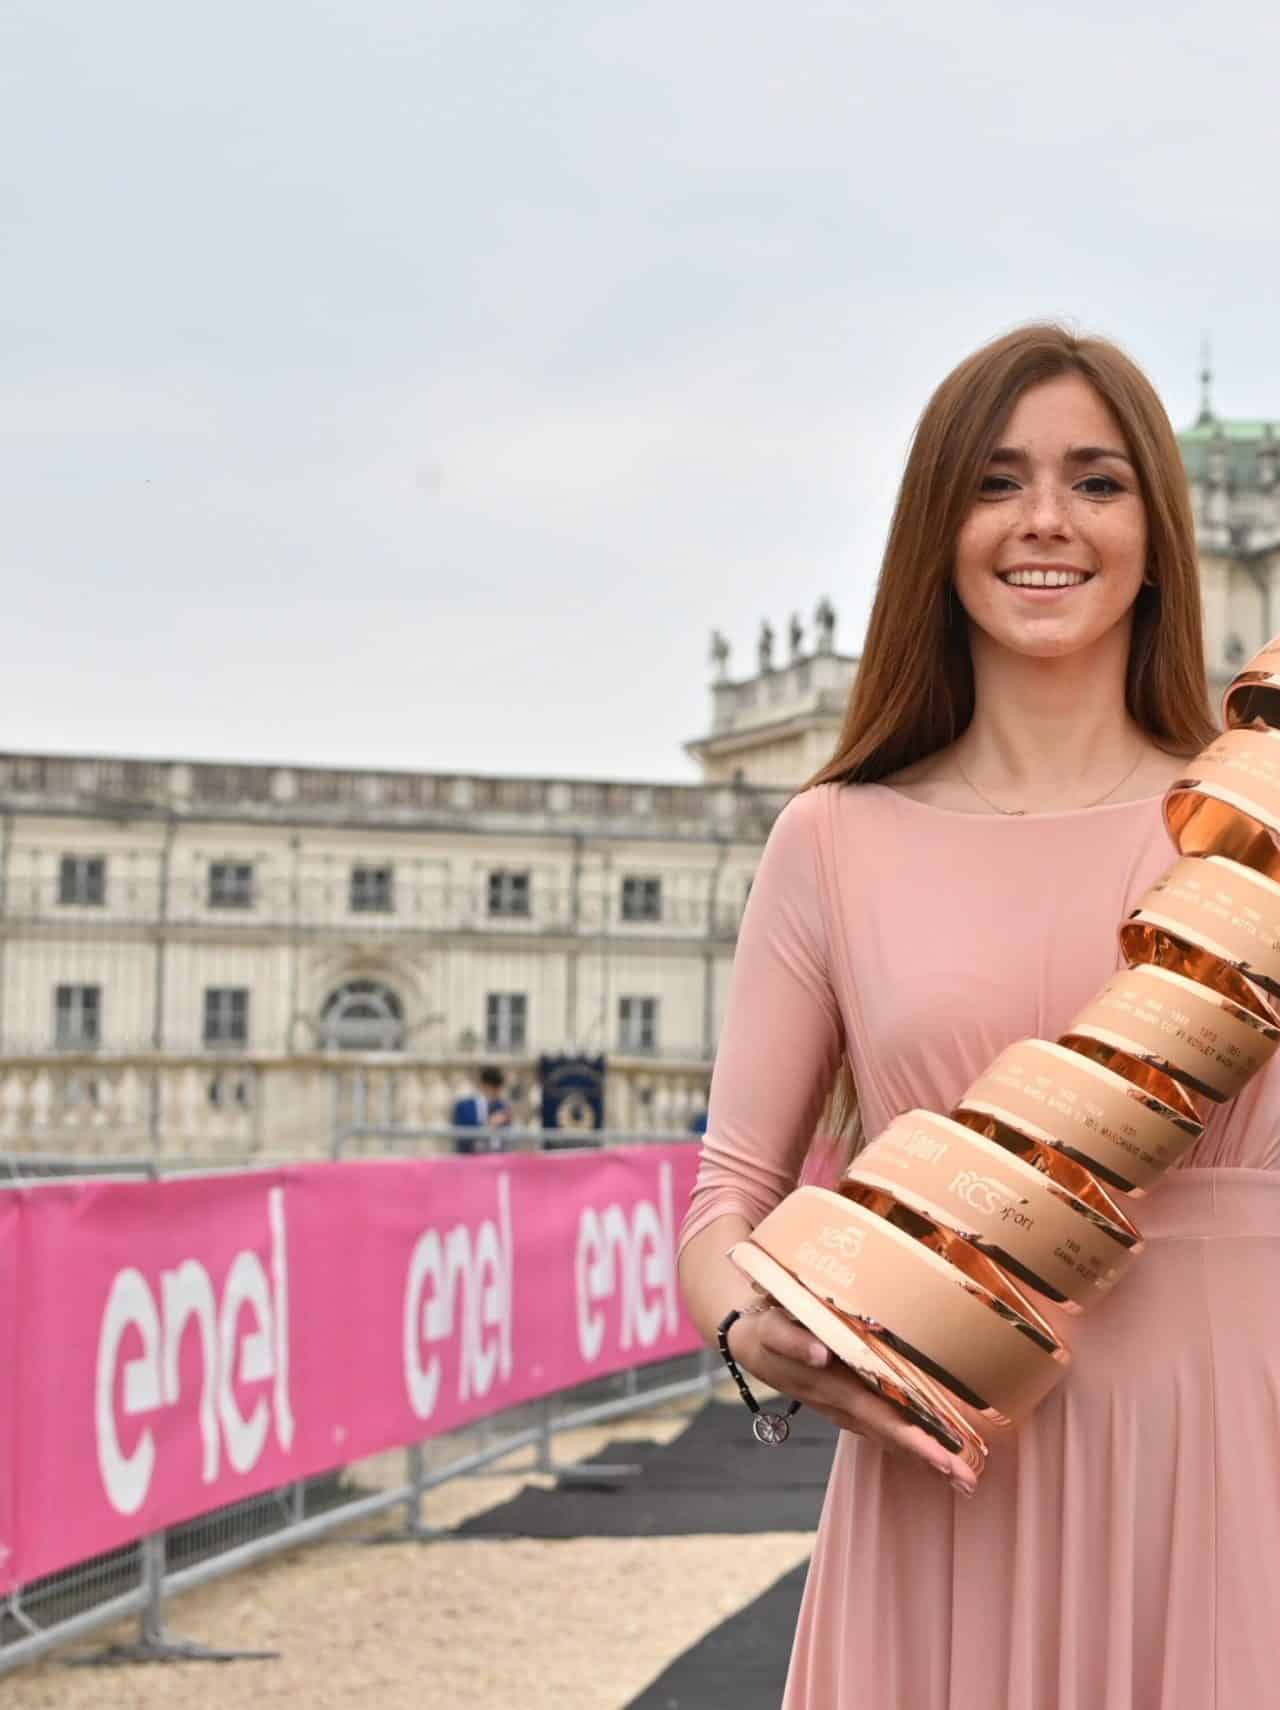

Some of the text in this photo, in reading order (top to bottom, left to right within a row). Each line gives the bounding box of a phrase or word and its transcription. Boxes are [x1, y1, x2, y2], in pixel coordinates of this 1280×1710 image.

[404, 1173, 514, 1421] enel
[574, 1161, 679, 1361] enel
[950, 1172, 1001, 1215] RCS
[96, 1186, 294, 1516] enel
